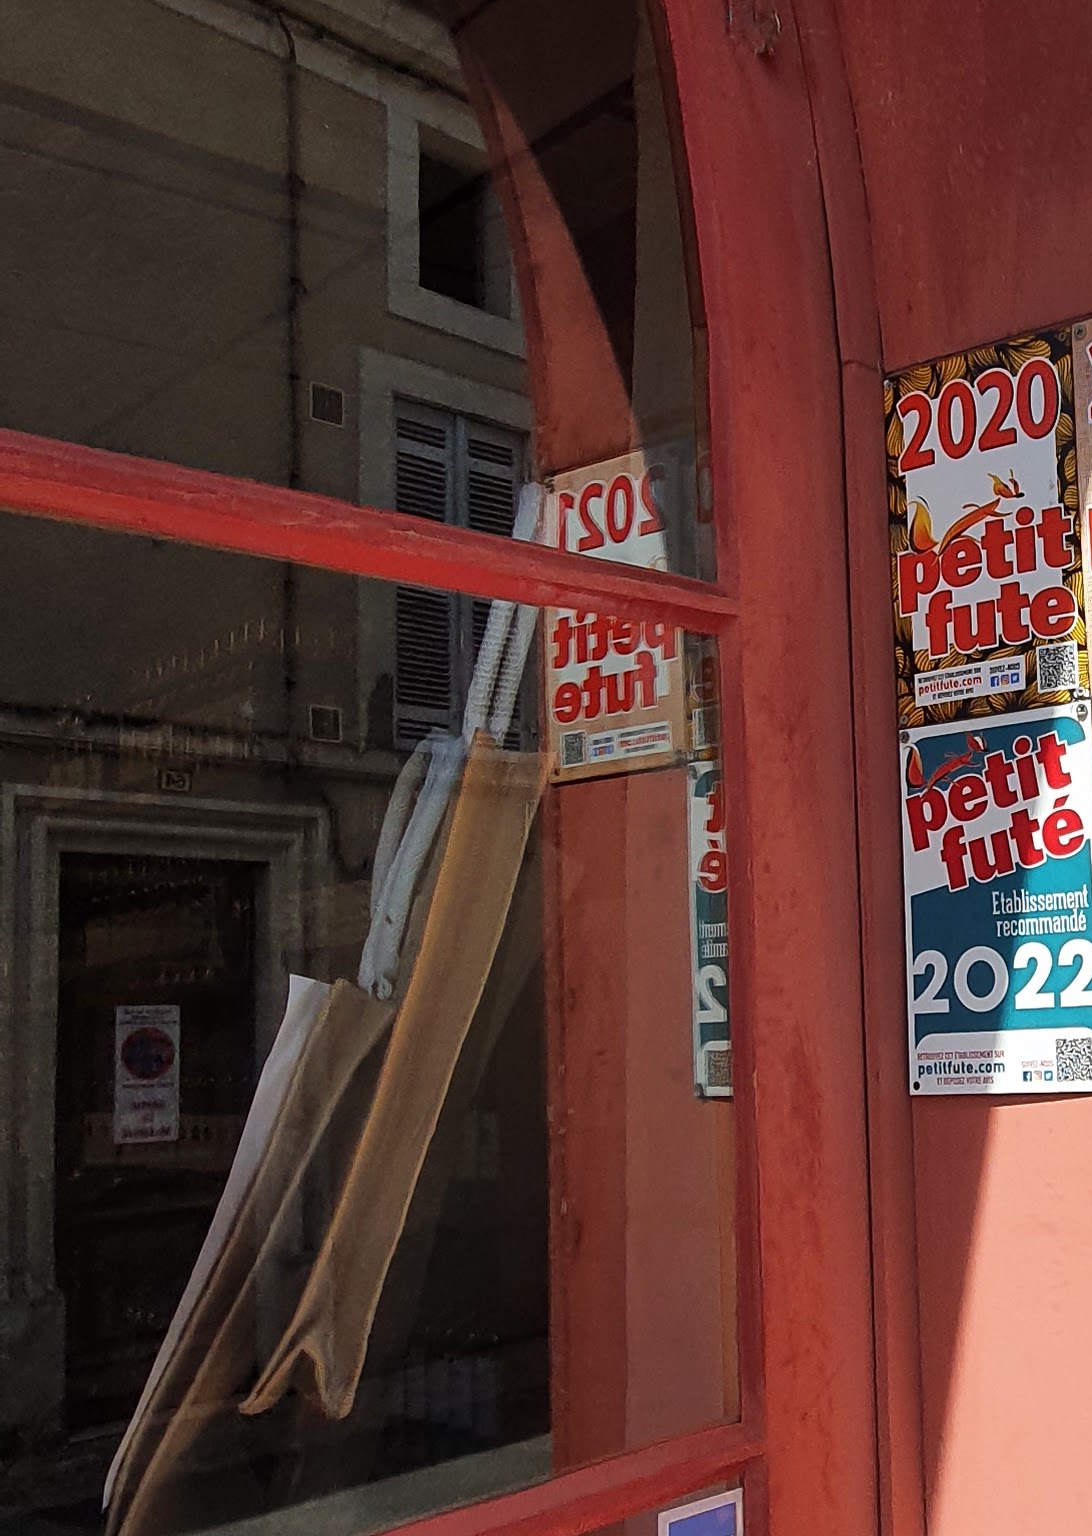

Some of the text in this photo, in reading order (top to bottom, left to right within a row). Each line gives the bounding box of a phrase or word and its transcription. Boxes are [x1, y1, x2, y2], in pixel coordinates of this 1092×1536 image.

[899, 359, 1059, 472] 2020
[899, 506, 1073, 615] petit
[925, 583, 1075, 657] fute
[918, 676, 982, 696] petitfute.com
[906, 732, 1071, 852] petit
[941, 795, 1085, 891] futé
[992, 889, 1089, 918] Etablissement
[996, 909, 1087, 938] recommandé
[918, 1061, 1005, 1078] petitfute.com
